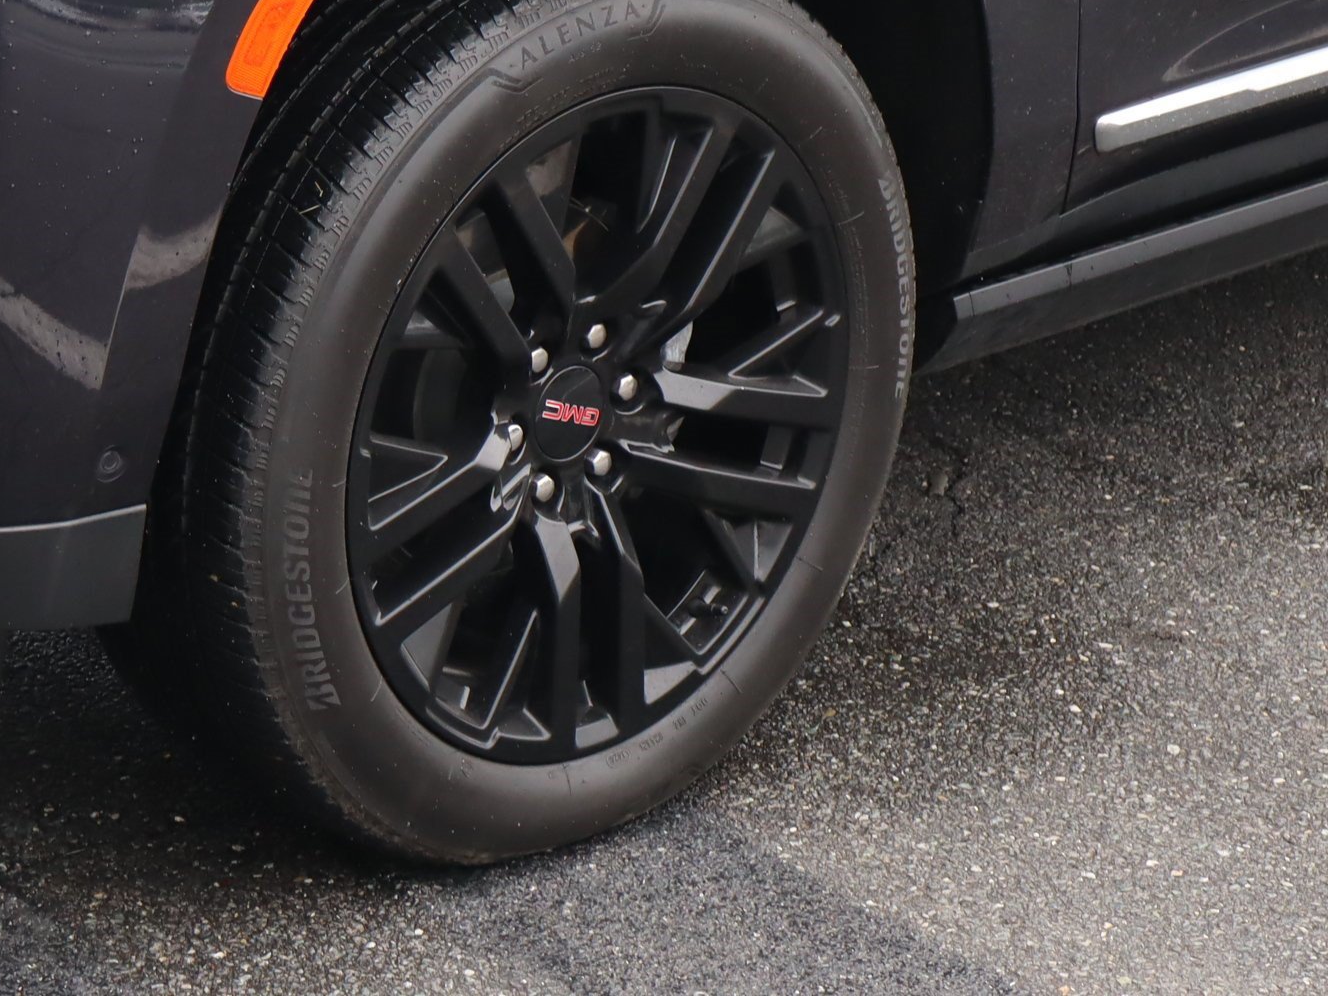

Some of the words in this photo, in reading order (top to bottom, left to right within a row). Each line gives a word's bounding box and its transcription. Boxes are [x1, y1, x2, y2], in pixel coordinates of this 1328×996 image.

[521, 0, 641, 70] ALENZA
[878, 171, 915, 399] BRIDGESTONE
[542, 399, 600, 426] GMC
[284, 468, 342, 711] BRIDGESTONE
